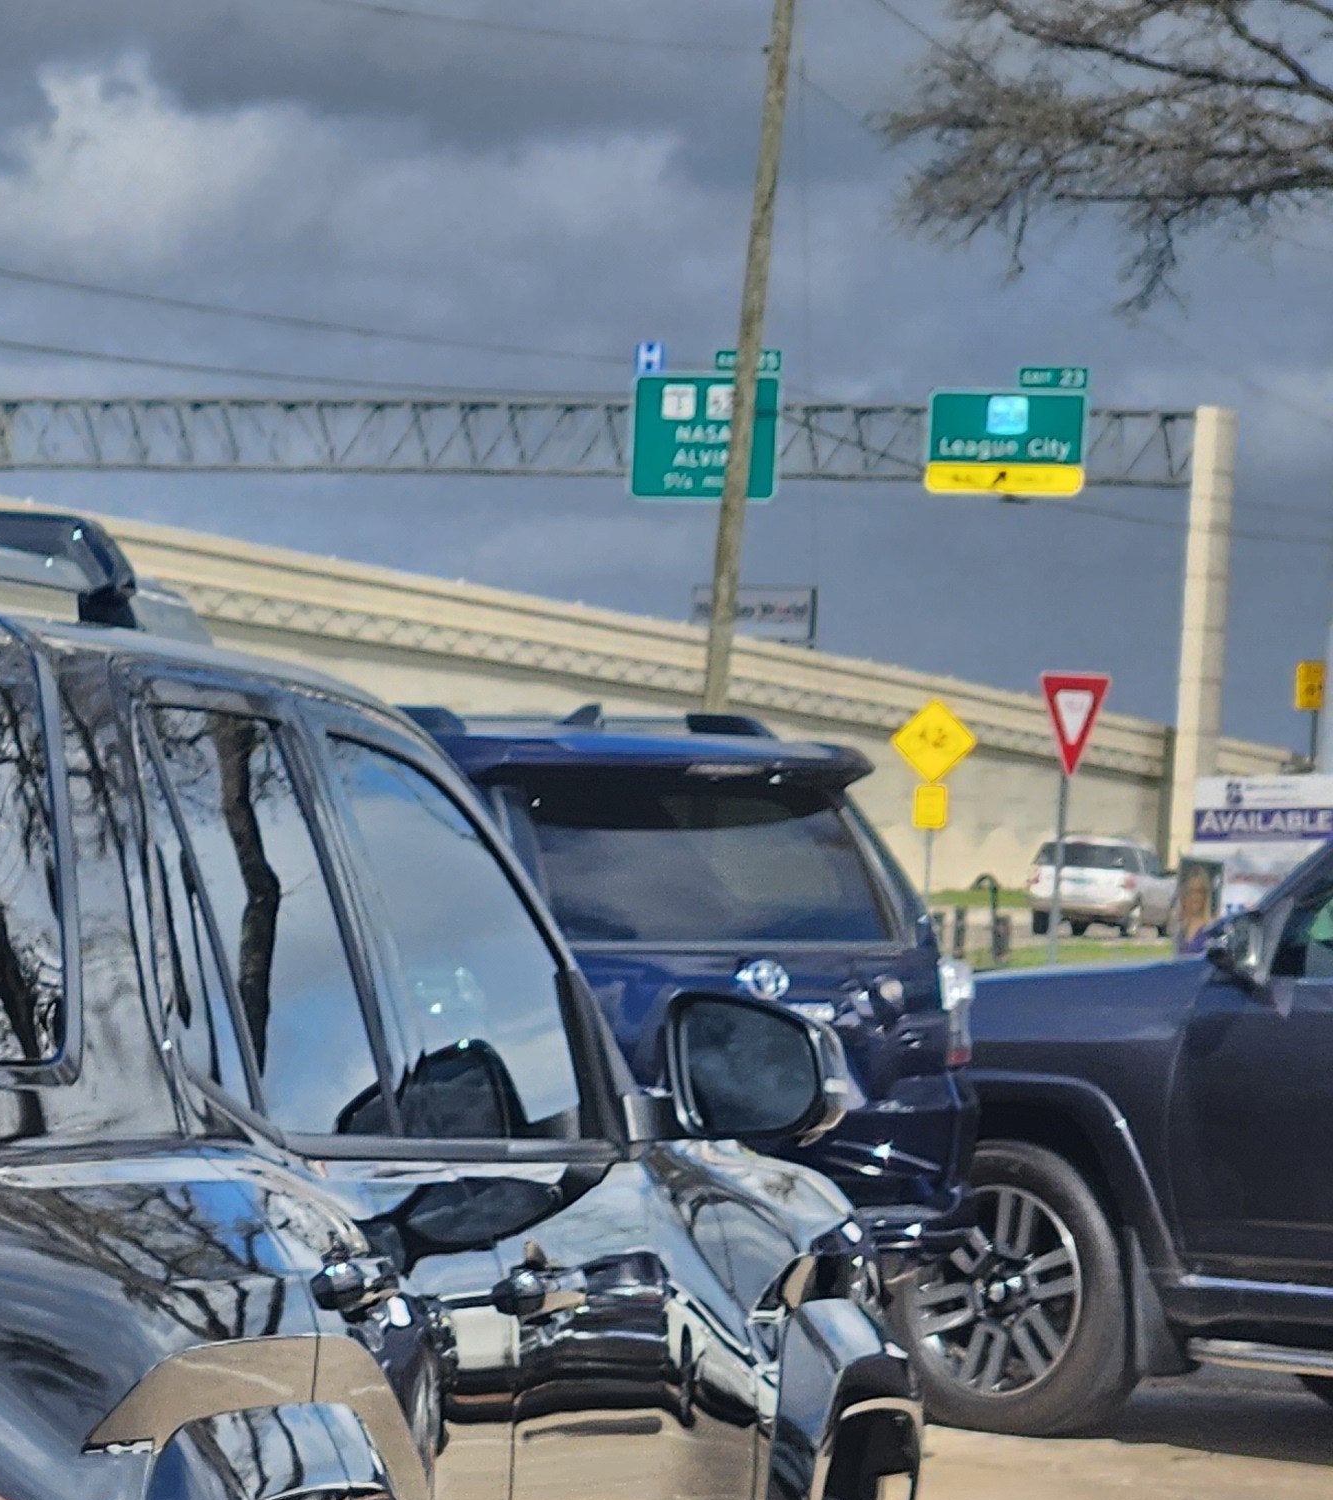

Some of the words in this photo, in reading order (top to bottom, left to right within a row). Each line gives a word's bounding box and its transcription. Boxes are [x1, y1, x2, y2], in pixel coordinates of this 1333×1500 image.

[638, 342, 663, 372] H
[939, 437, 1019, 460] League
[1027, 437, 1071, 461] City
[1200, 809, 1333, 834] AVAILABLE
